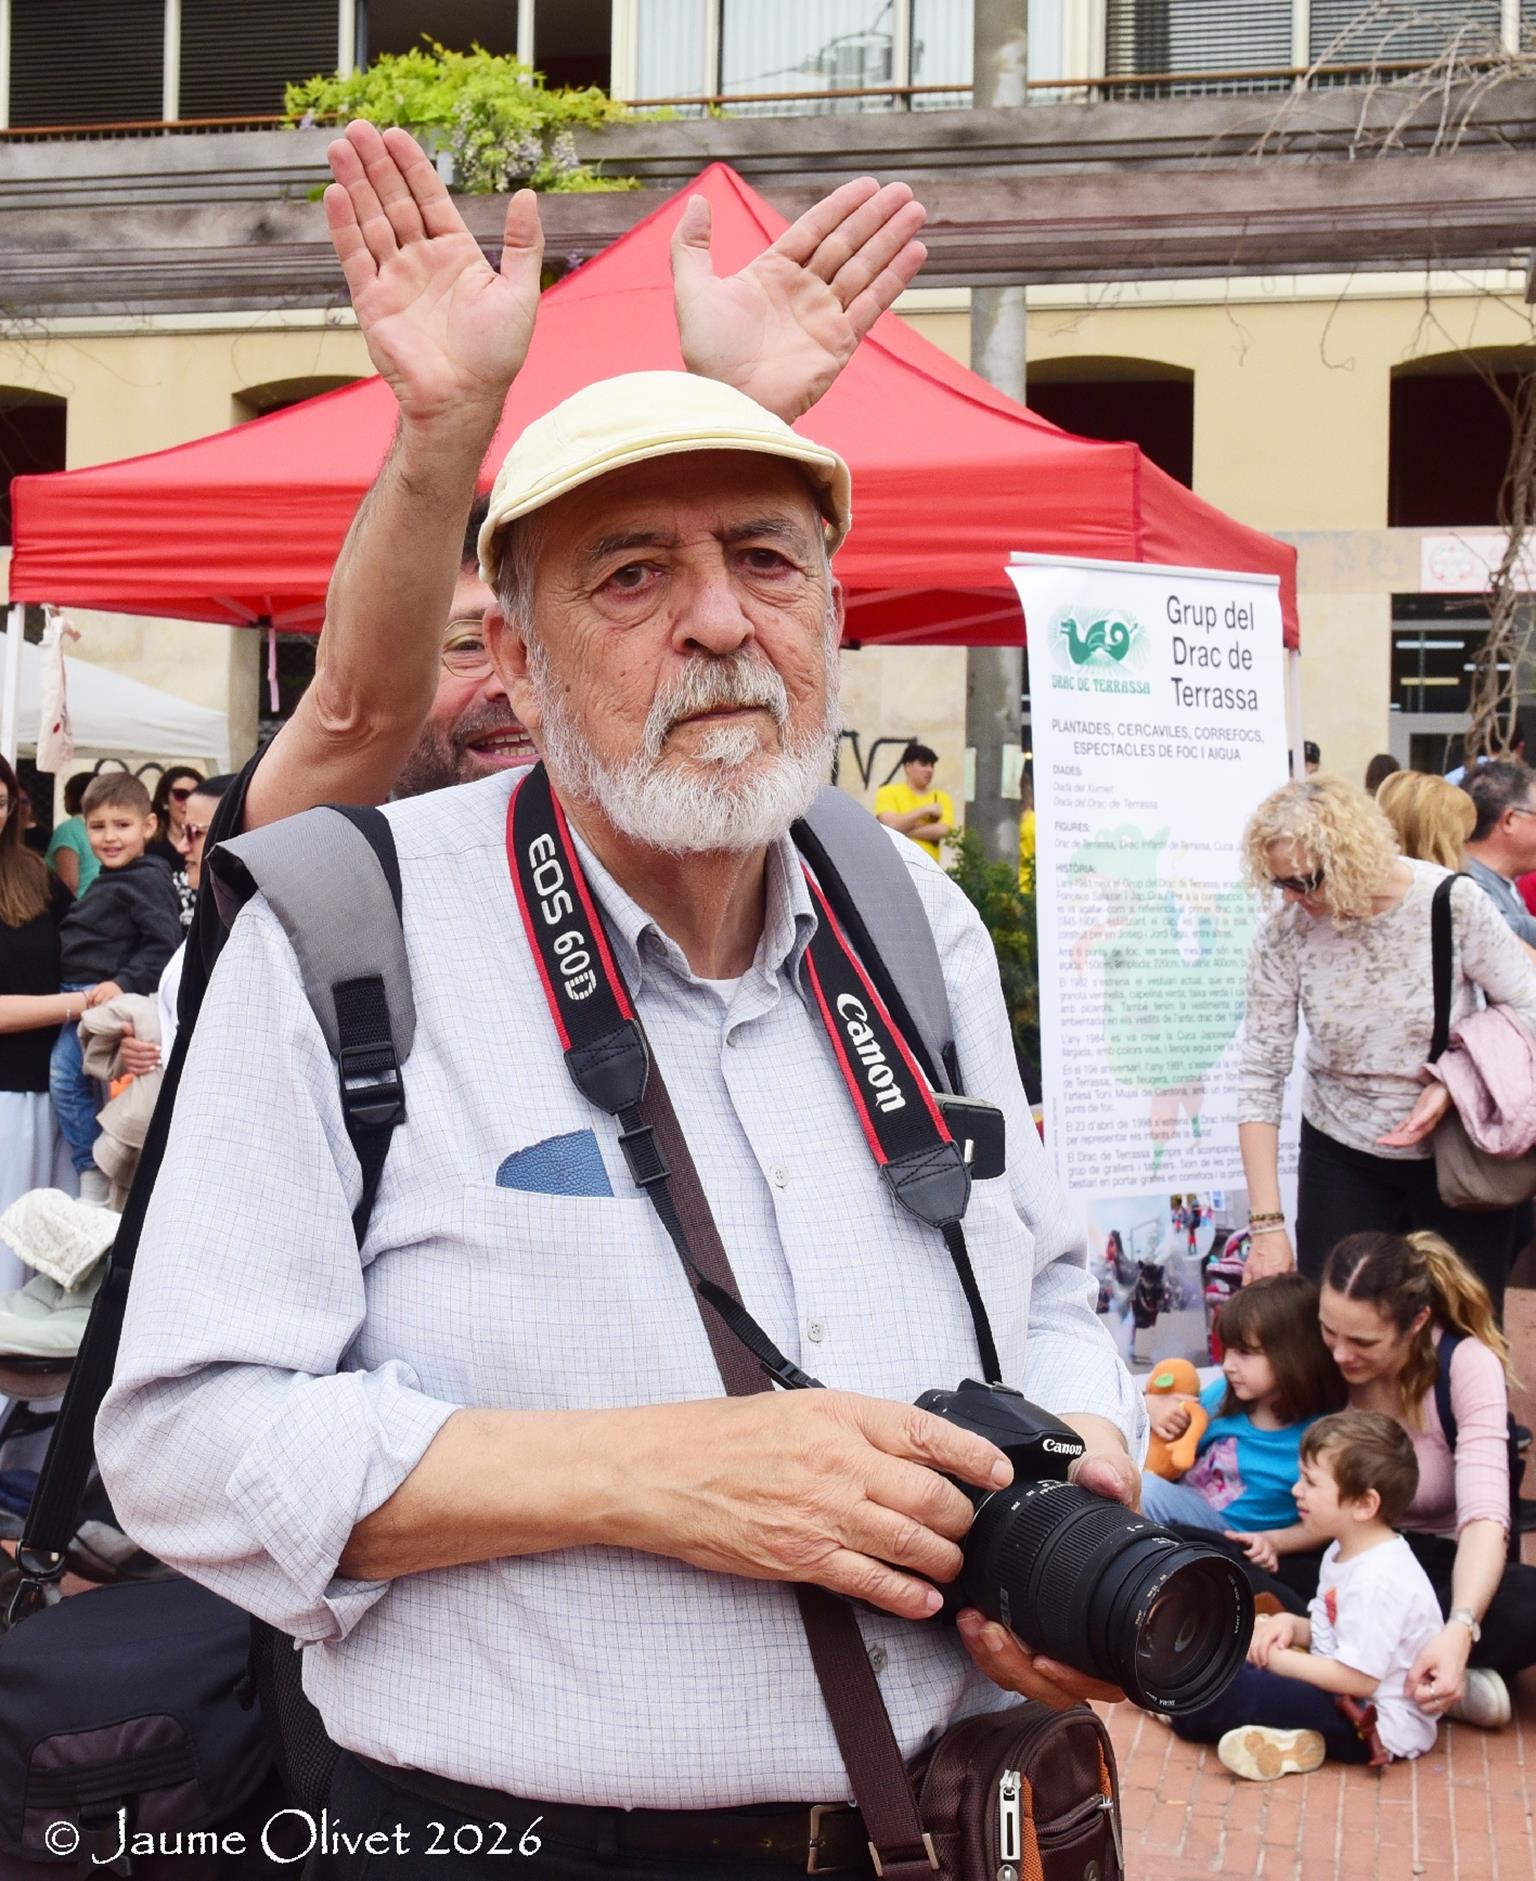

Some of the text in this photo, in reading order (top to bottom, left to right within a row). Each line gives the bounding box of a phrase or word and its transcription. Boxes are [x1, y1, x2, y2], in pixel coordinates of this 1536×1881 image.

[1167, 595, 1254, 634] Grup del
[1173, 636, 1253, 670] Drac de
[1052, 674, 1151, 695] DRAC DE TERRASSA
[1171, 677, 1258, 711] Terrassa
[1052, 719, 1264, 744] PLANTADES, CERCAVILES, CORREFOCS,
[1073, 741, 1241, 761] ESPECTACLES DE FOC I AIGUA
[529, 833, 597, 1001] EOS 60D
[836, 993, 906, 1113] Canon
[1042, 1438, 1083, 1456] Canon
